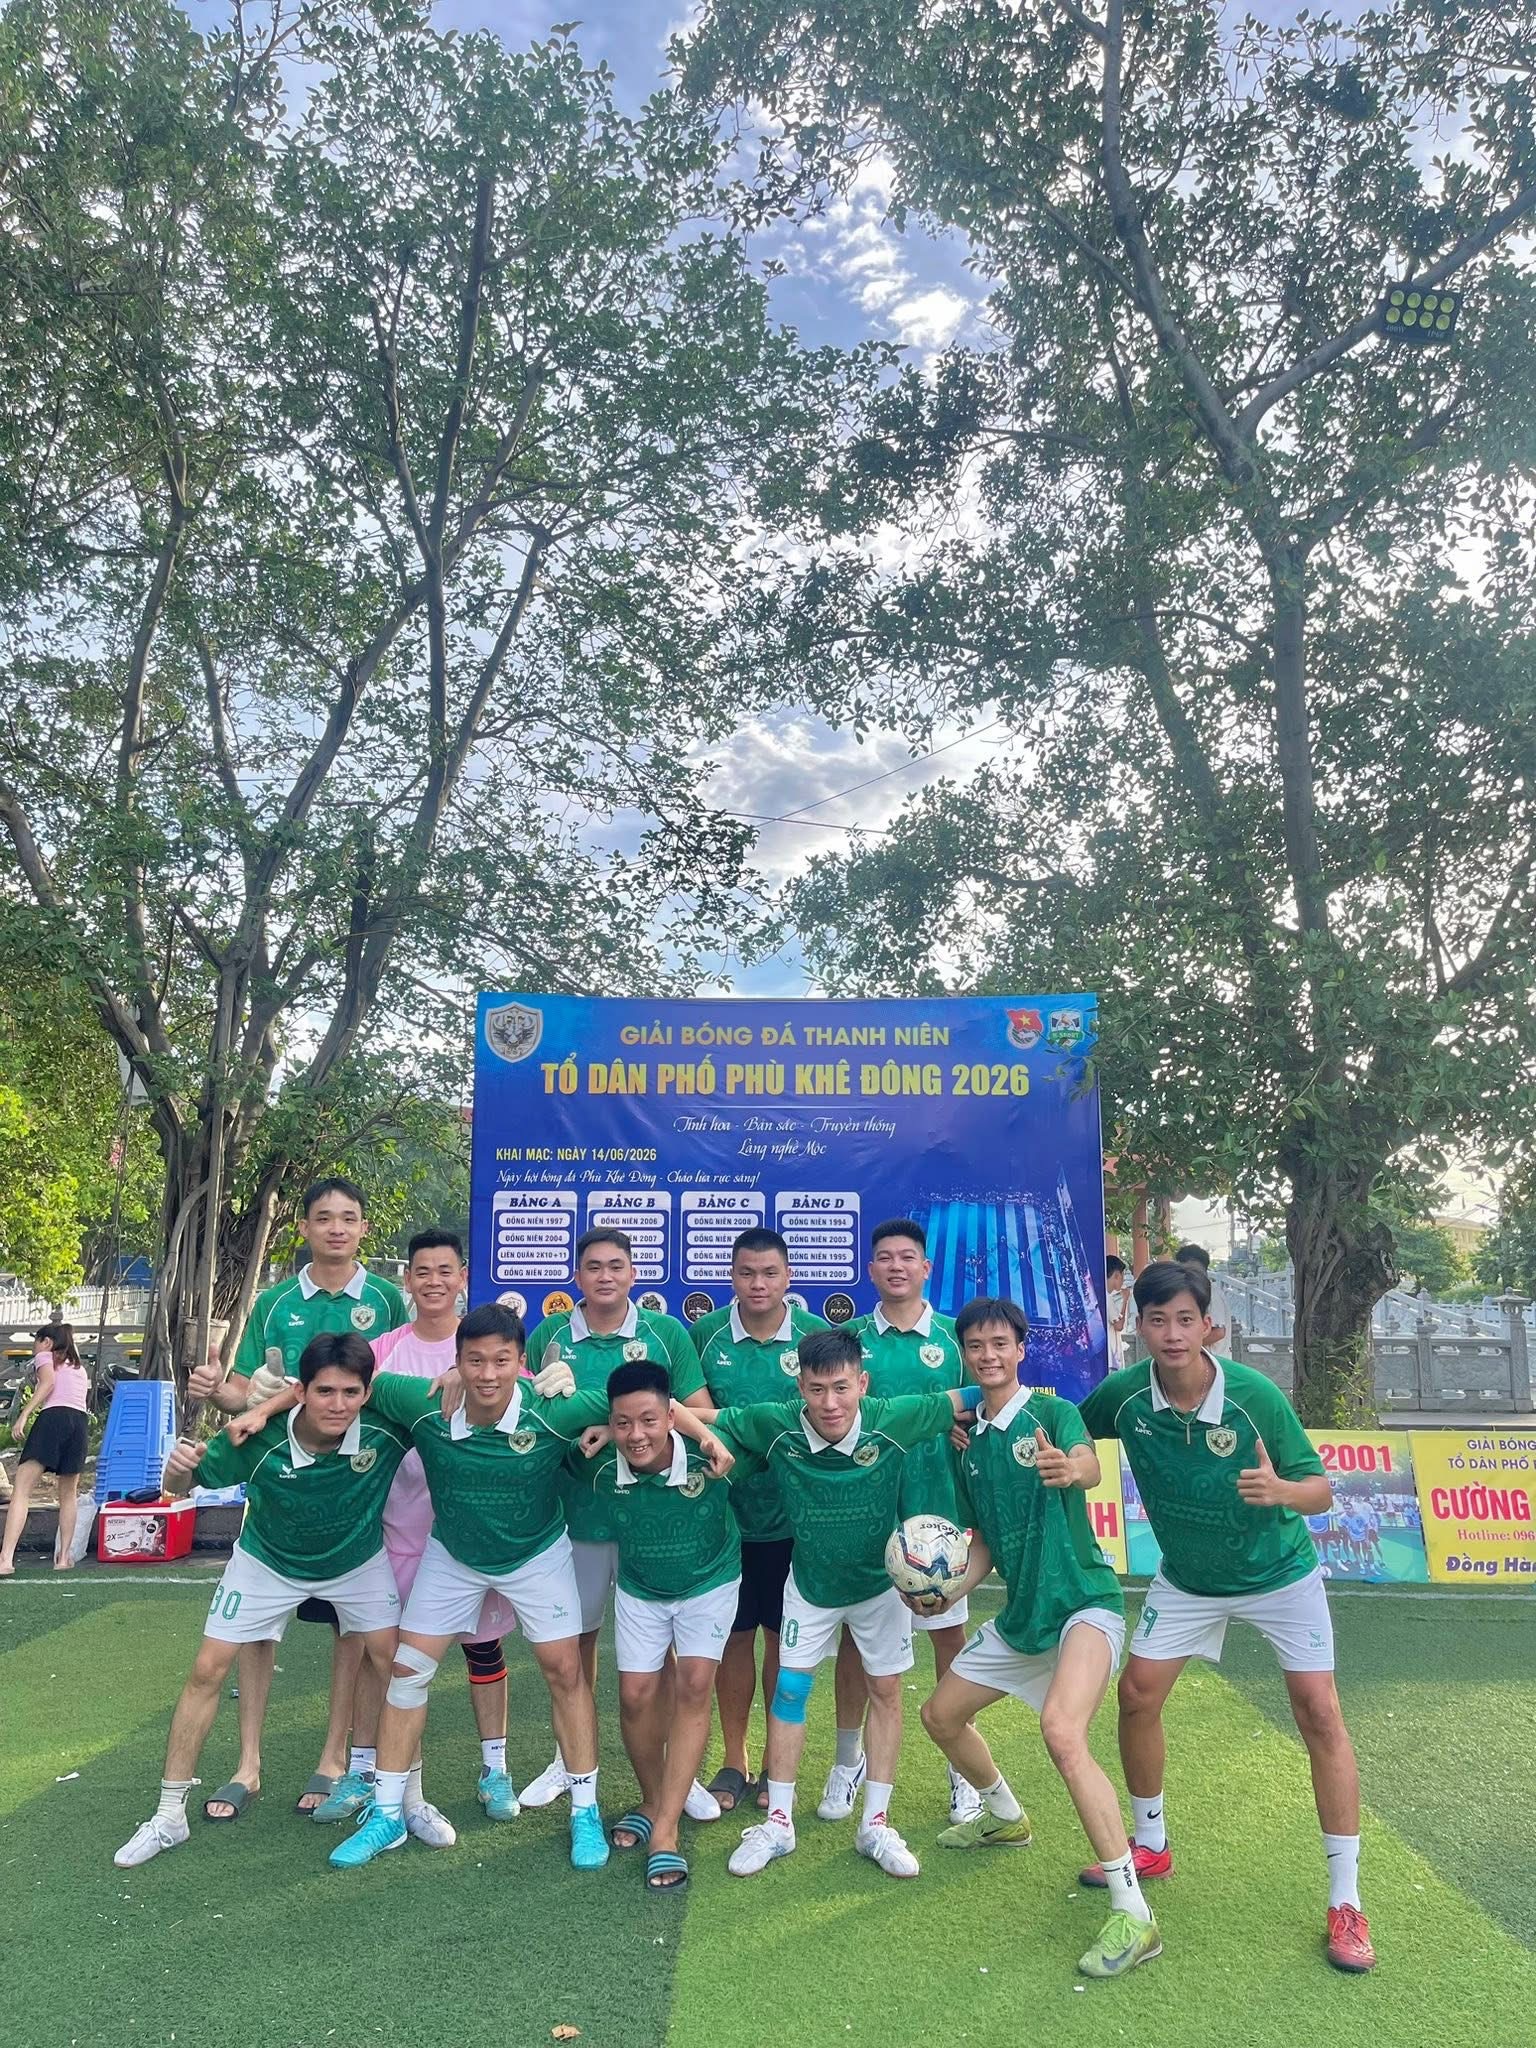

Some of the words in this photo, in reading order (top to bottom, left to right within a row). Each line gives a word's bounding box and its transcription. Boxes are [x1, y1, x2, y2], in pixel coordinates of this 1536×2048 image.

[620, 1019, 672, 1045] GIẢI
[681, 1021, 752, 1046] BÓNG
[761, 1021, 797, 1046] ĐÁ
[804, 1026, 885, 1046] THANH
[894, 1022, 949, 1046] NIÊN
[541, 1052, 579, 1095] TỔ
[588, 1059, 646, 1095] DÂN
[657, 1053, 715, 1095] PHỐ
[726, 1058, 785, 1095] PHÙ
[795, 1058, 850, 1096] KHÊ
[860, 1058, 942, 1096] ĐÔNG
[951, 1063, 1030, 1097] 2026
[709, 1114, 731, 1131] hoa
[496, 1148, 522, 1161] KHAI
[526, 1148, 553, 1163] MẠC:
[557, 1147, 587, 1161] NGÀY
[592, 1148, 657, 1162] 14/06/2026
[737, 1137, 768, 1161] Làng
[509, 1194, 548, 1208] BẢNG
[552, 1197, 562, 1208] A
[603, 1194, 643, 1208] BẢNG
[646, 1198, 656, 1208] B
[697, 1194, 736, 1208] BẢNG
[740, 1198, 750, 1208] C
[791, 1194, 831, 1208] BẢNG
[834, 1198, 845, 1208] D
[545, 1217, 563, 1225] 1997
[1467, 1436, 1495, 1450] GIẢI
[1499, 1437, 1536, 1451] BÓNG
[1318, 1444, 1393, 1473] 2001
[1448, 1453, 1465, 1469] TỔ
[1469, 1456, 1498, 1470] DÂN
[1501, 1454, 1530, 1470] PHỐ
[1430, 1481, 1532, 1521] CƯỜNG
[1457, 1529, 1511, 1541] Hotline:
[1446, 1553, 1498, 1575] Đồng
